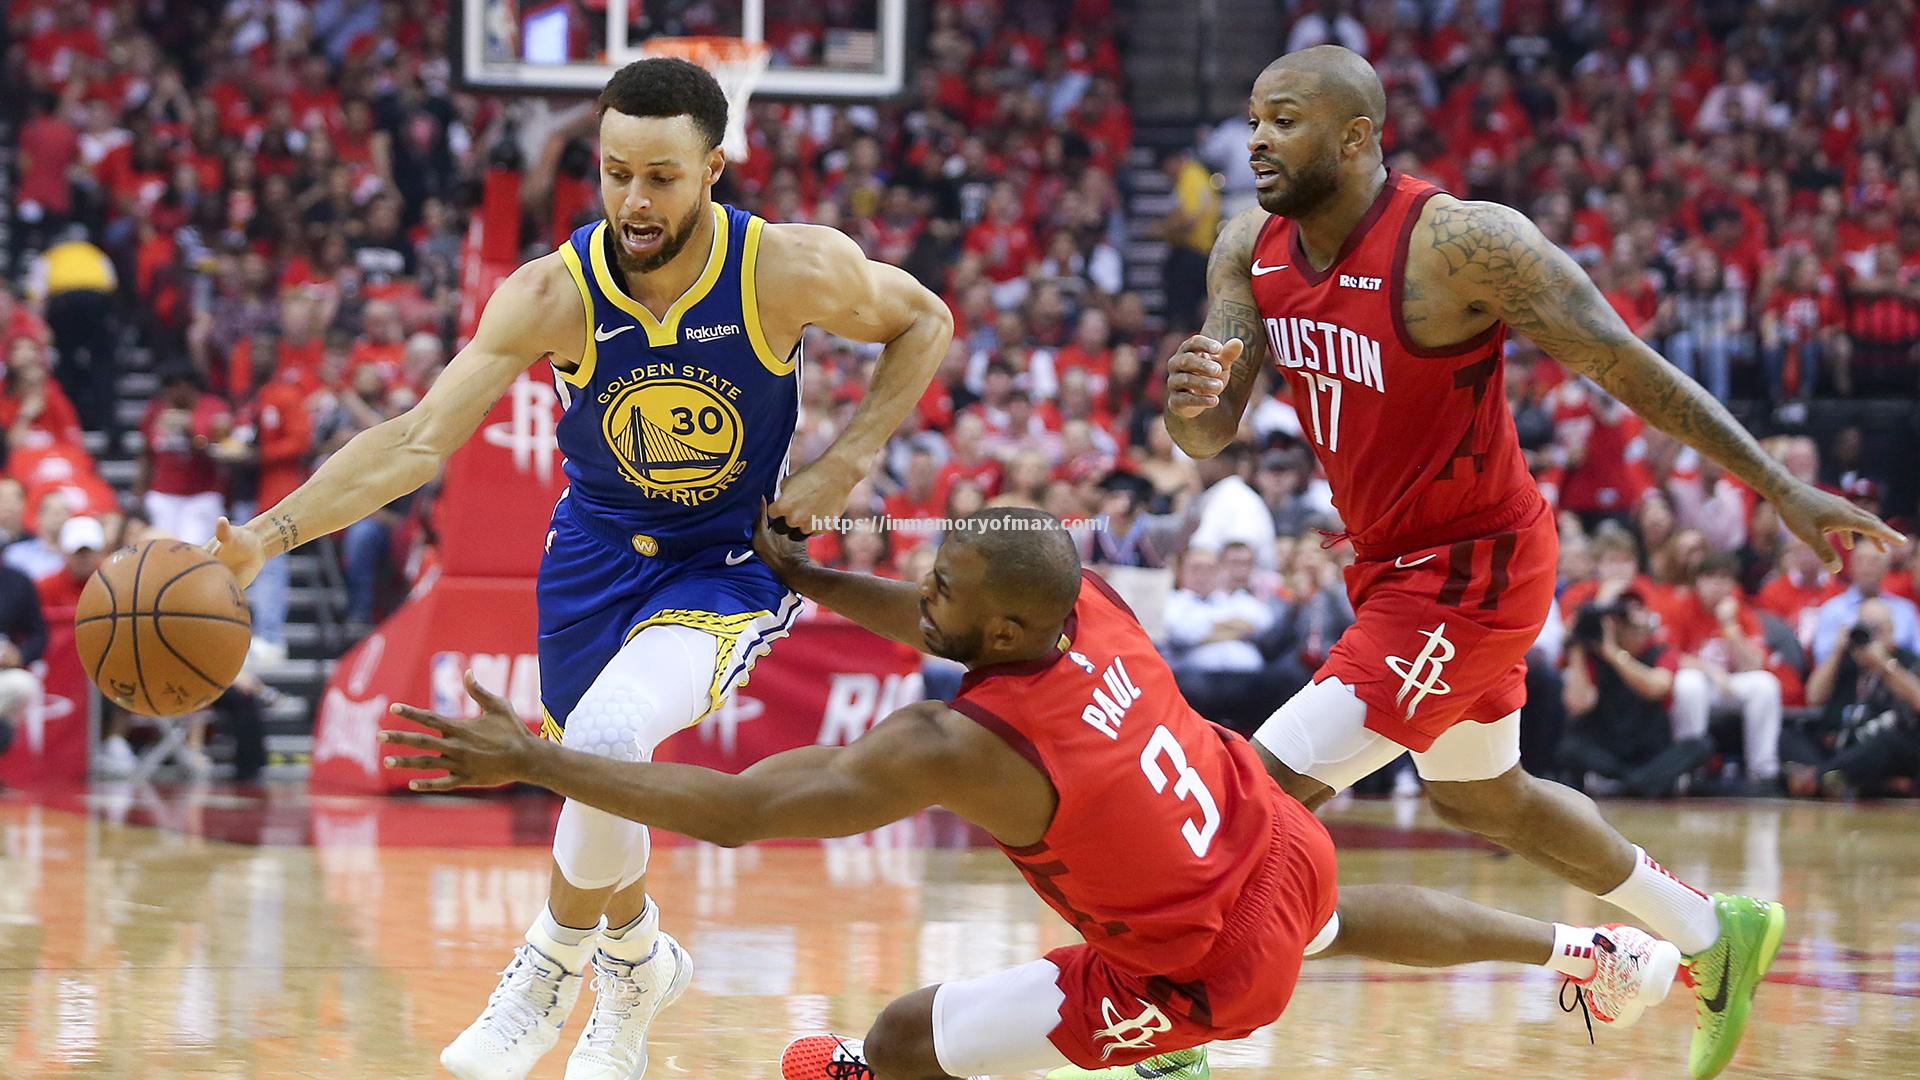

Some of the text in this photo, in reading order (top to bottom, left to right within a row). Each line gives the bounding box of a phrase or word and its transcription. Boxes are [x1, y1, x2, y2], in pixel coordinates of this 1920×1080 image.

[685, 323, 740, 341] Rakuten
[1263, 317, 1385, 393] OUSTON
[597, 362, 742, 404] GOLDEN STATE
[1297, 370, 1342, 453] 17
[670, 405, 724, 436] 30
[617, 460, 747, 507] WARRIORS
[1081, 655, 1142, 741] PAUL
[1139, 724, 1221, 858] 3
